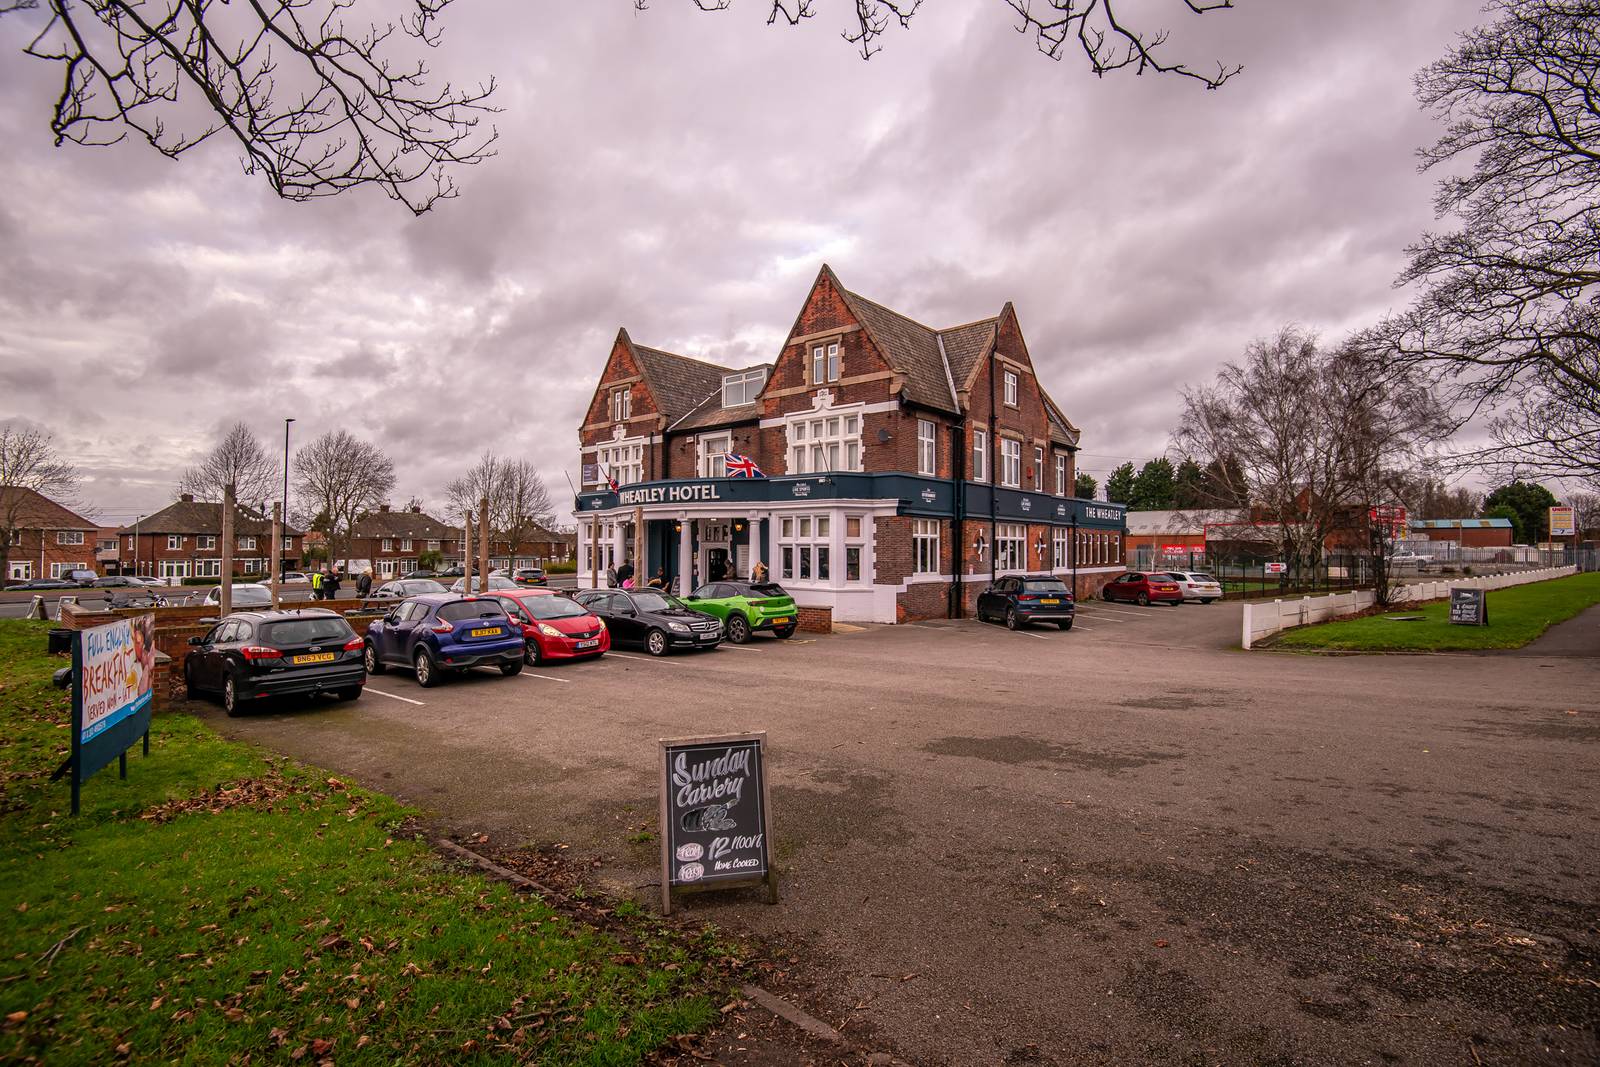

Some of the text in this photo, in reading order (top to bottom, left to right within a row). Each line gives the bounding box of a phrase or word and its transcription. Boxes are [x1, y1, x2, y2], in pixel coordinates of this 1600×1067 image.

[620, 488, 666, 504] WHEATLEY
[669, 484, 721, 500] HOTEL
[1086, 507, 1121, 520] THE WHEATLEY
[88, 625, 131, 661] FULL ENGLI
[82, 648, 134, 704] BREAKFAT
[673, 748, 750, 787] Sunday
[676, 777, 744, 807] Carvery
[708, 836, 732, 861] 12
